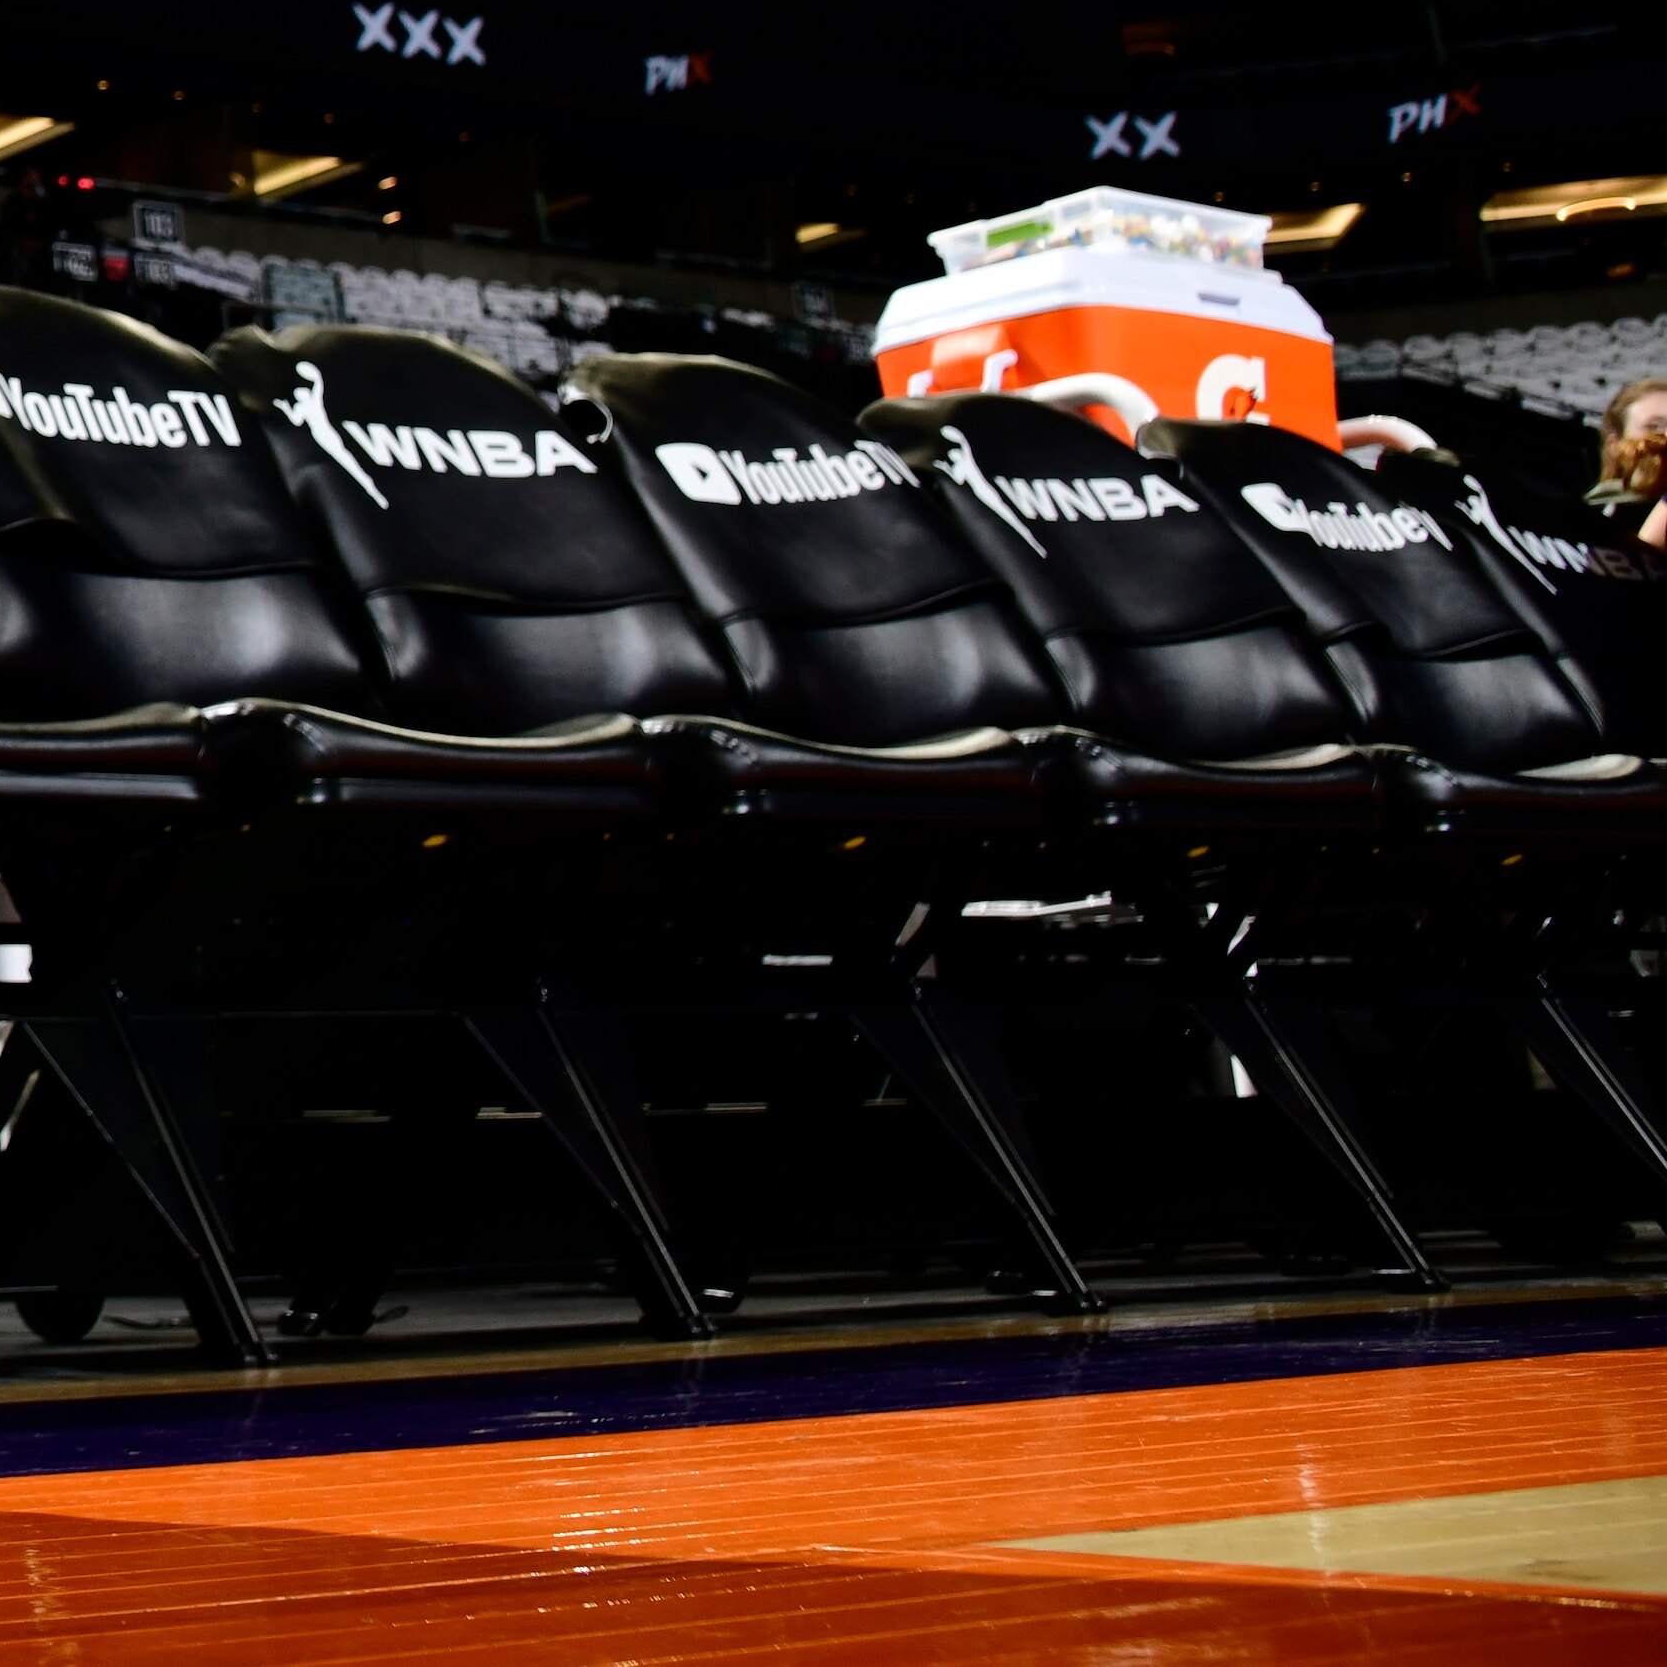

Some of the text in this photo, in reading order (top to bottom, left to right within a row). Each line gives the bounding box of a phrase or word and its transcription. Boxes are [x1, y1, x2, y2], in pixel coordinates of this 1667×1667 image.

[643, 49, 714, 98] PHX
[1386, 81, 1484, 145] PHX
[341, 420, 599, 479] WNBA
[993, 472, 1200, 523] WNBA
